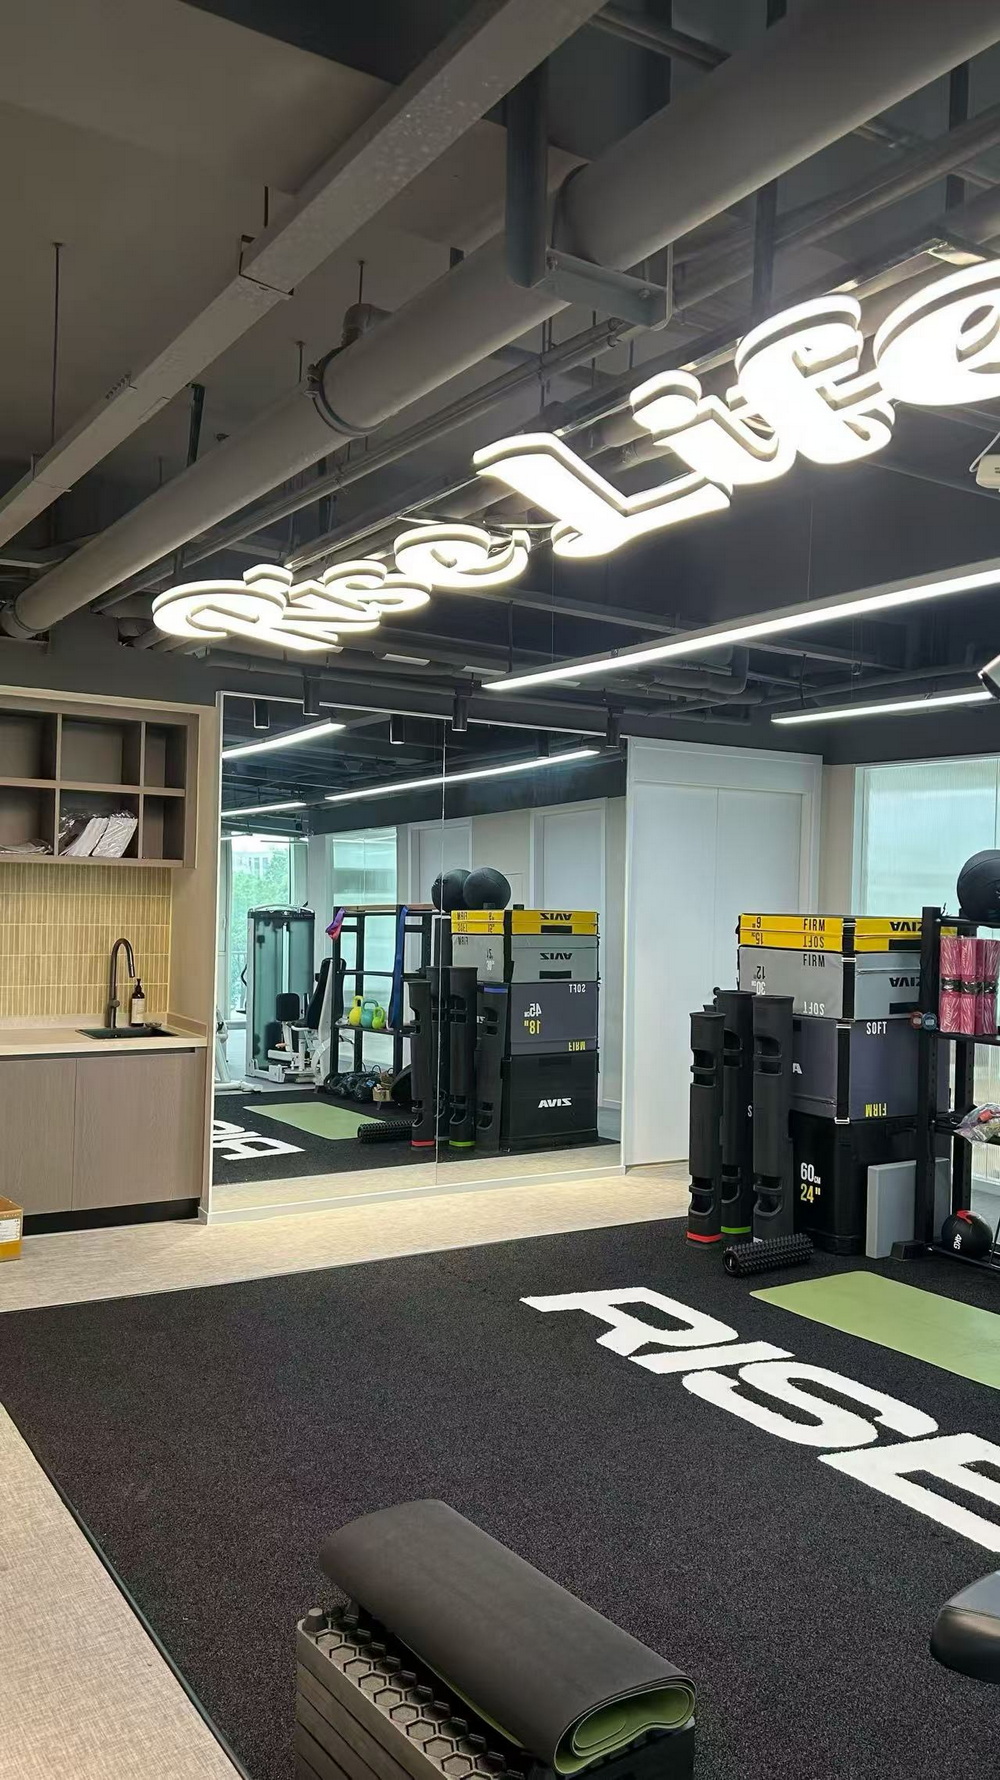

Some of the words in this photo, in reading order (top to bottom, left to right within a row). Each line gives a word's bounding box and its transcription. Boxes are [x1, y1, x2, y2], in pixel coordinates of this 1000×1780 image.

[153, 522, 531, 652] Rise
[474, 257, 1000, 558] Life
[803, 918, 826, 931] FIRM
[803, 935, 825, 948] SOFT
[803, 953, 826, 968] FIRM
[803, 1001, 826, 1016] SOFT
[866, 1021, 888, 1035] SOFT
[865, 1103, 887, 1118] FIRM
[953, 1233, 963, 1250] 4KG
[519, 1286, 1000, 1553] RISE
